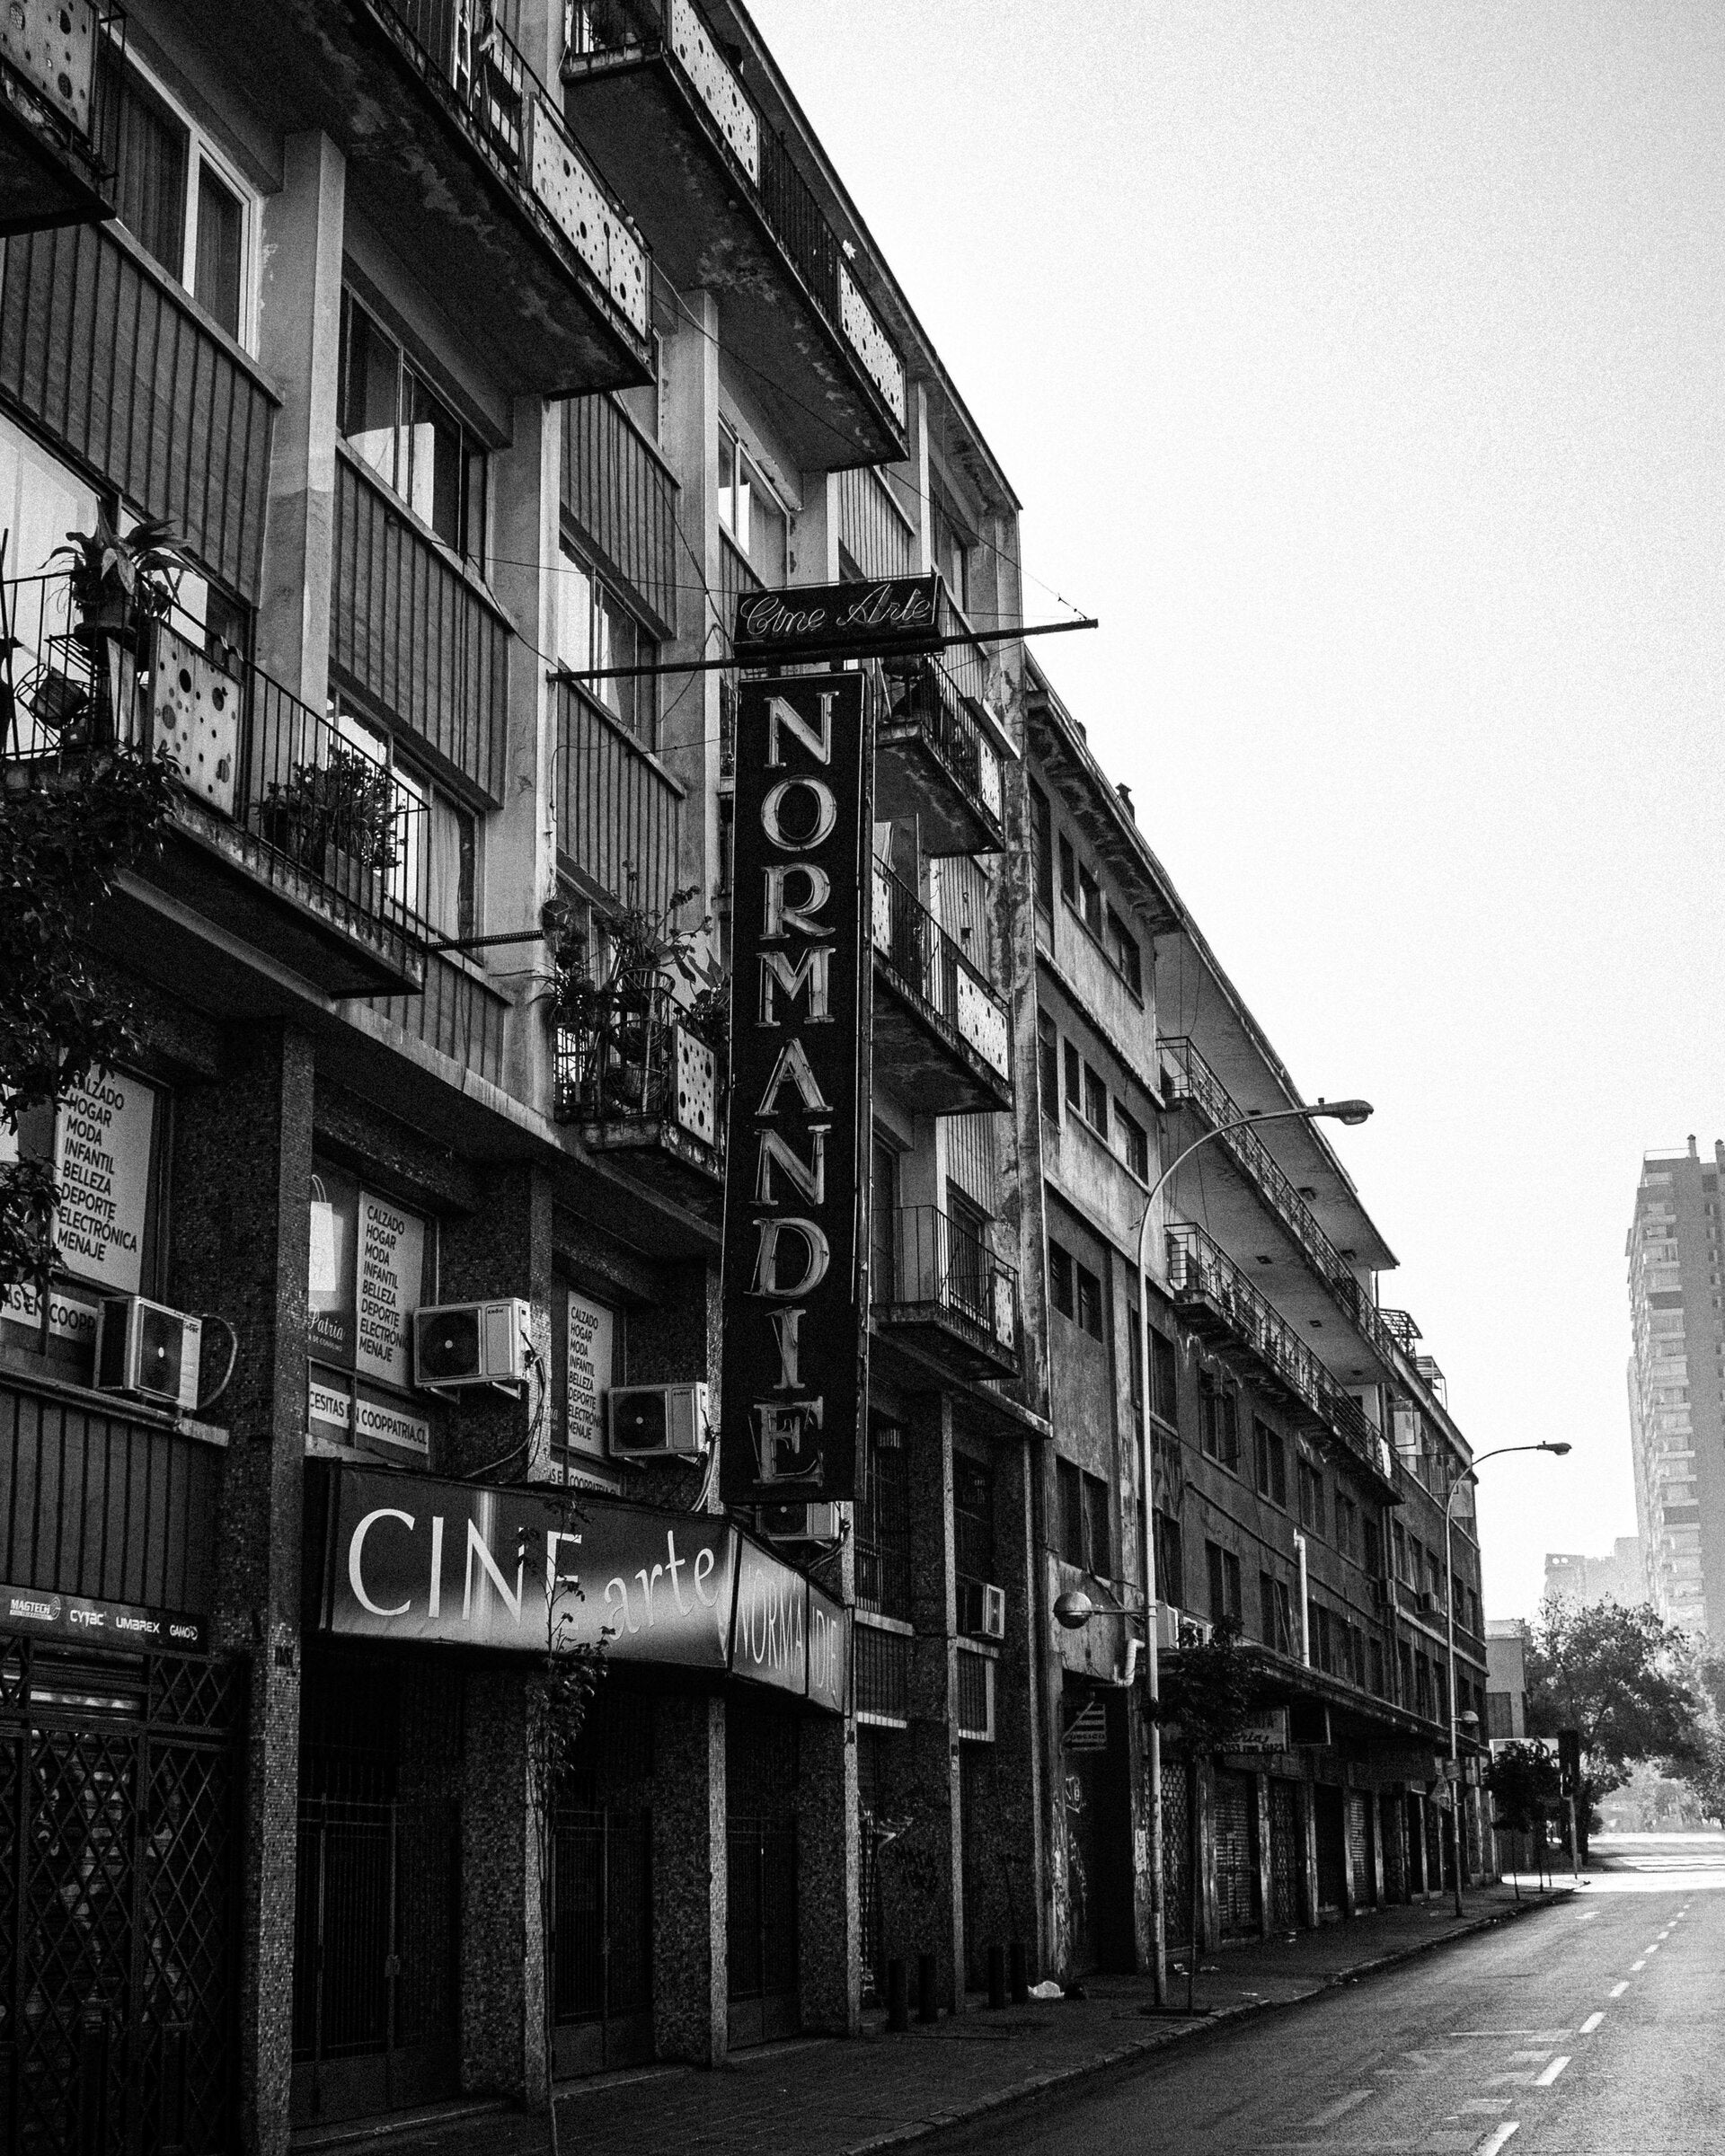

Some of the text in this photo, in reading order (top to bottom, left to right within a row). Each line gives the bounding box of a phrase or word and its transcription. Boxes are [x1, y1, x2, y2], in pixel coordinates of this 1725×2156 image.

[740, 584, 931, 634] Cine Arte
[744, 690, 840, 1488] NORMANDIE
[69, 1092, 112, 1128] HOGAR
[66, 1115, 102, 1147] MODA
[65, 1137, 115, 1175] INFANTIL
[63, 1160, 111, 1196] BELLEZA
[61, 1182, 117, 1220] DEPORTE
[58, 1206, 137, 1253] ELECTRÓNICA
[367, 1205, 405, 1235] CALZADO
[58, 1228, 107, 1261] MENAJE
[366, 1224, 397, 1250] HOGAR
[365, 1241, 390, 1267] MODA
[363, 1260, 399, 1289] INFANTIL
[362, 1279, 396, 1308] BELLEZA
[361, 1298, 401, 1328] DEPORTE
[571, 1305, 599, 1330] CALZADO
[571, 1321, 593, 1344] HOGAR
[359, 1337, 394, 1363] MENAJE
[570, 1339, 588, 1358] MODA
[569, 1354, 595, 1377] INFANTIL
[569, 1371, 593, 1392] BELLEZA
[568, 1386, 597, 1410] DEPORTE
[348, 1508, 720, 1641] CINE arte
[10, 1598, 51, 1614] MAGTECH
[116, 1616, 160, 1634] UMAREX
